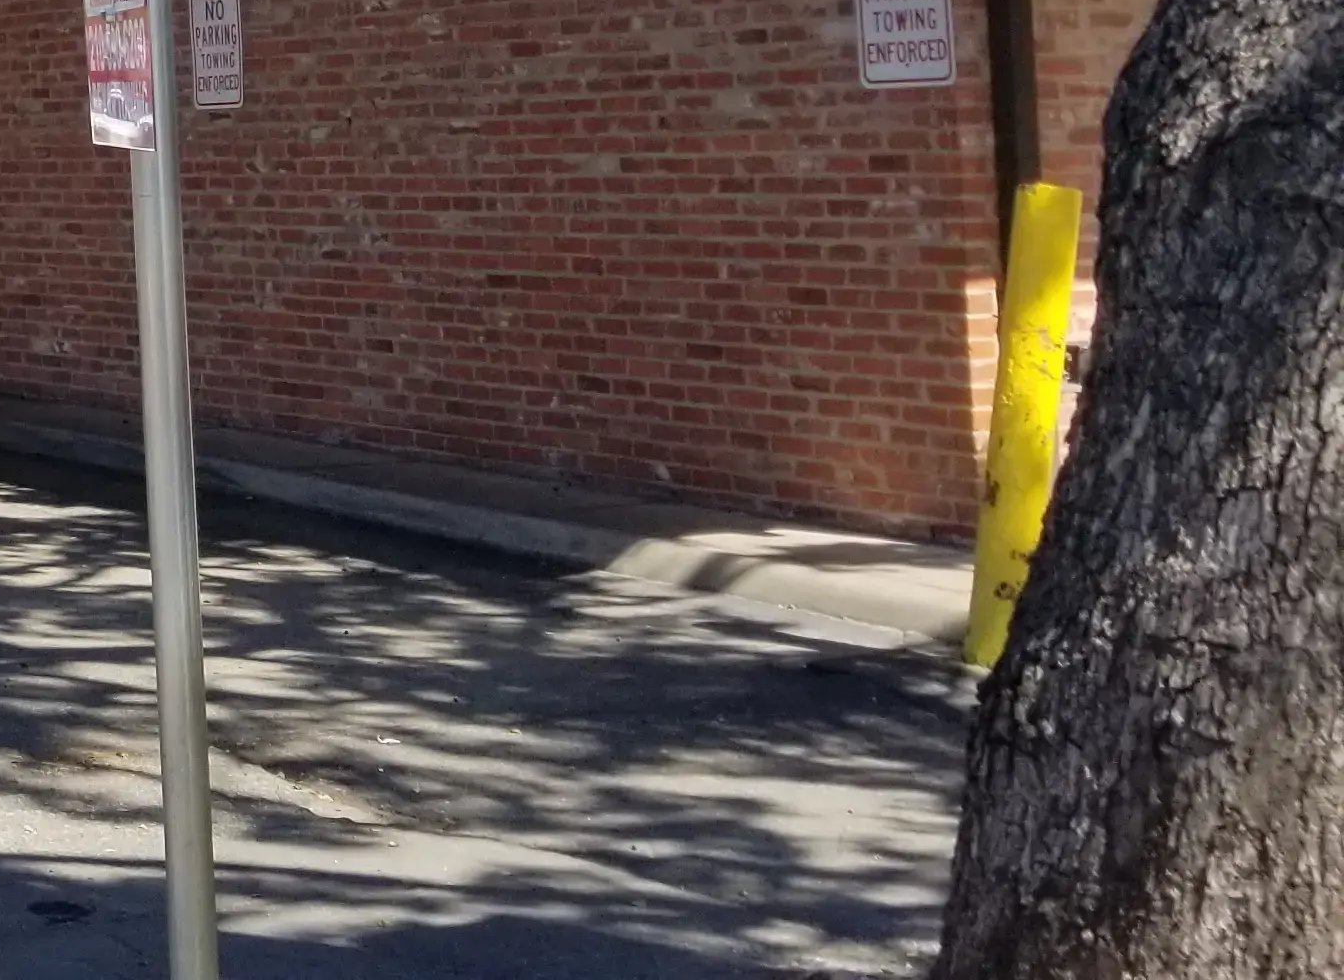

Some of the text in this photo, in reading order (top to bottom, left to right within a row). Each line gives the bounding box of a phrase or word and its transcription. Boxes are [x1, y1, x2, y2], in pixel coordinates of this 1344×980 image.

[205, 0, 224, 21] NO
[873, 8, 937, 32] TOWING
[196, 24, 237, 48] PARKING
[201, 52, 235, 69] TOWING
[867, 38, 947, 64] ENFORCED
[198, 75, 240, 92] ENFORCED
